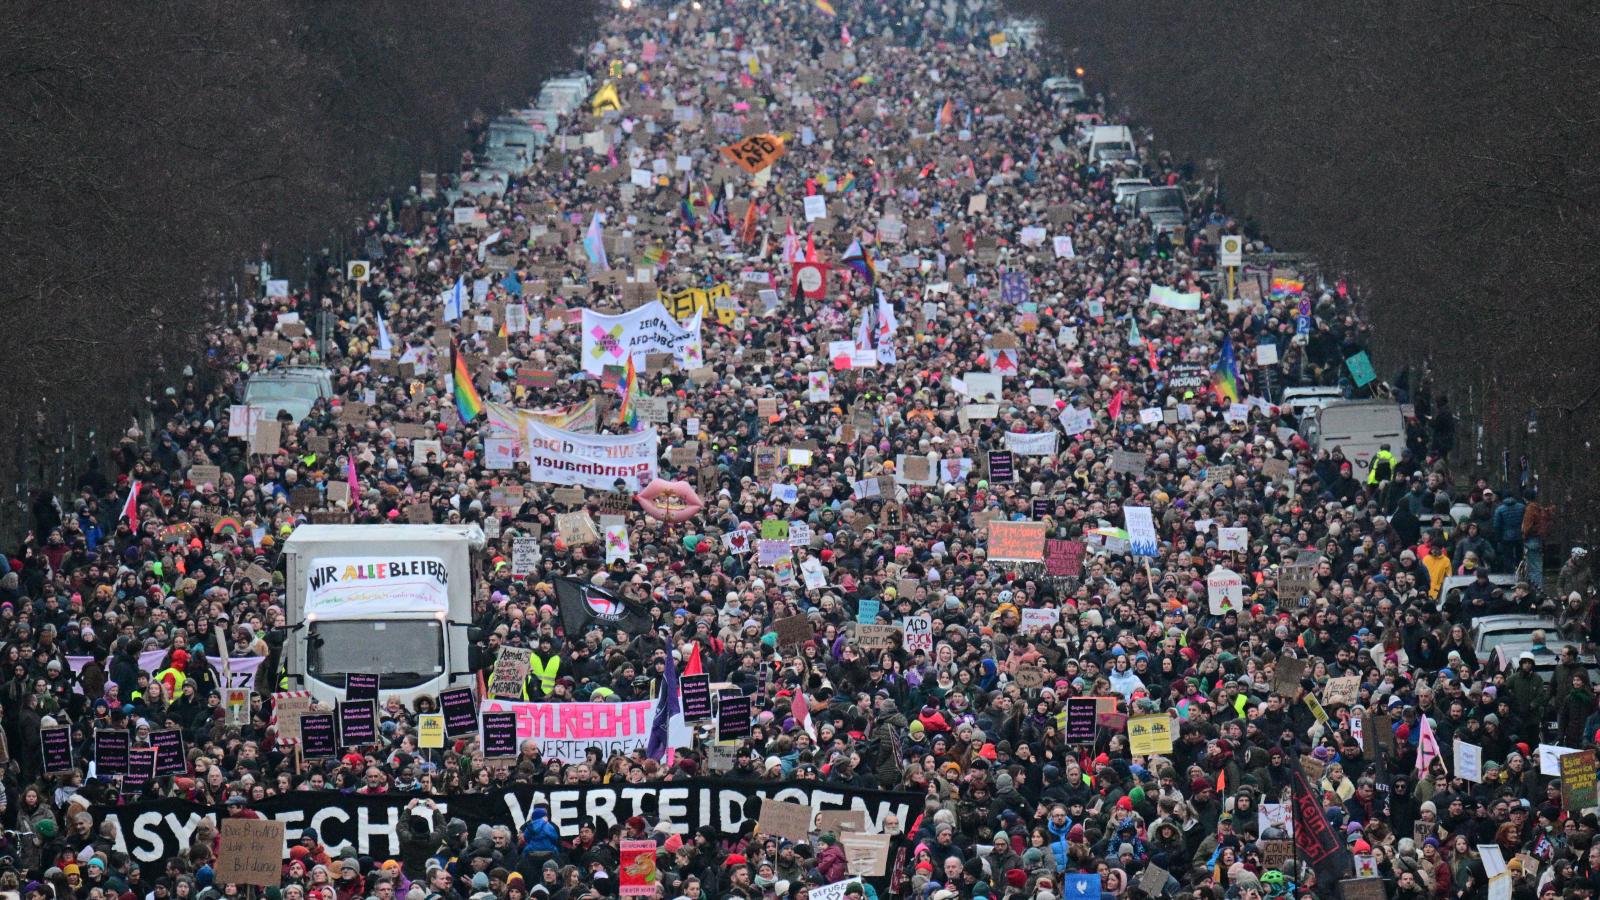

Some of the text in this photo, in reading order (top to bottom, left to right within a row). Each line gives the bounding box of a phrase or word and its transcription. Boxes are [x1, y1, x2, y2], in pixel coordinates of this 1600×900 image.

[1169, 377, 1201, 388] ANSTAND
[309, 560, 449, 591] WIR ALLE BLEIBEN
[907, 633, 931, 644] FUCK
[104, 803, 447, 863] ASYECHT
